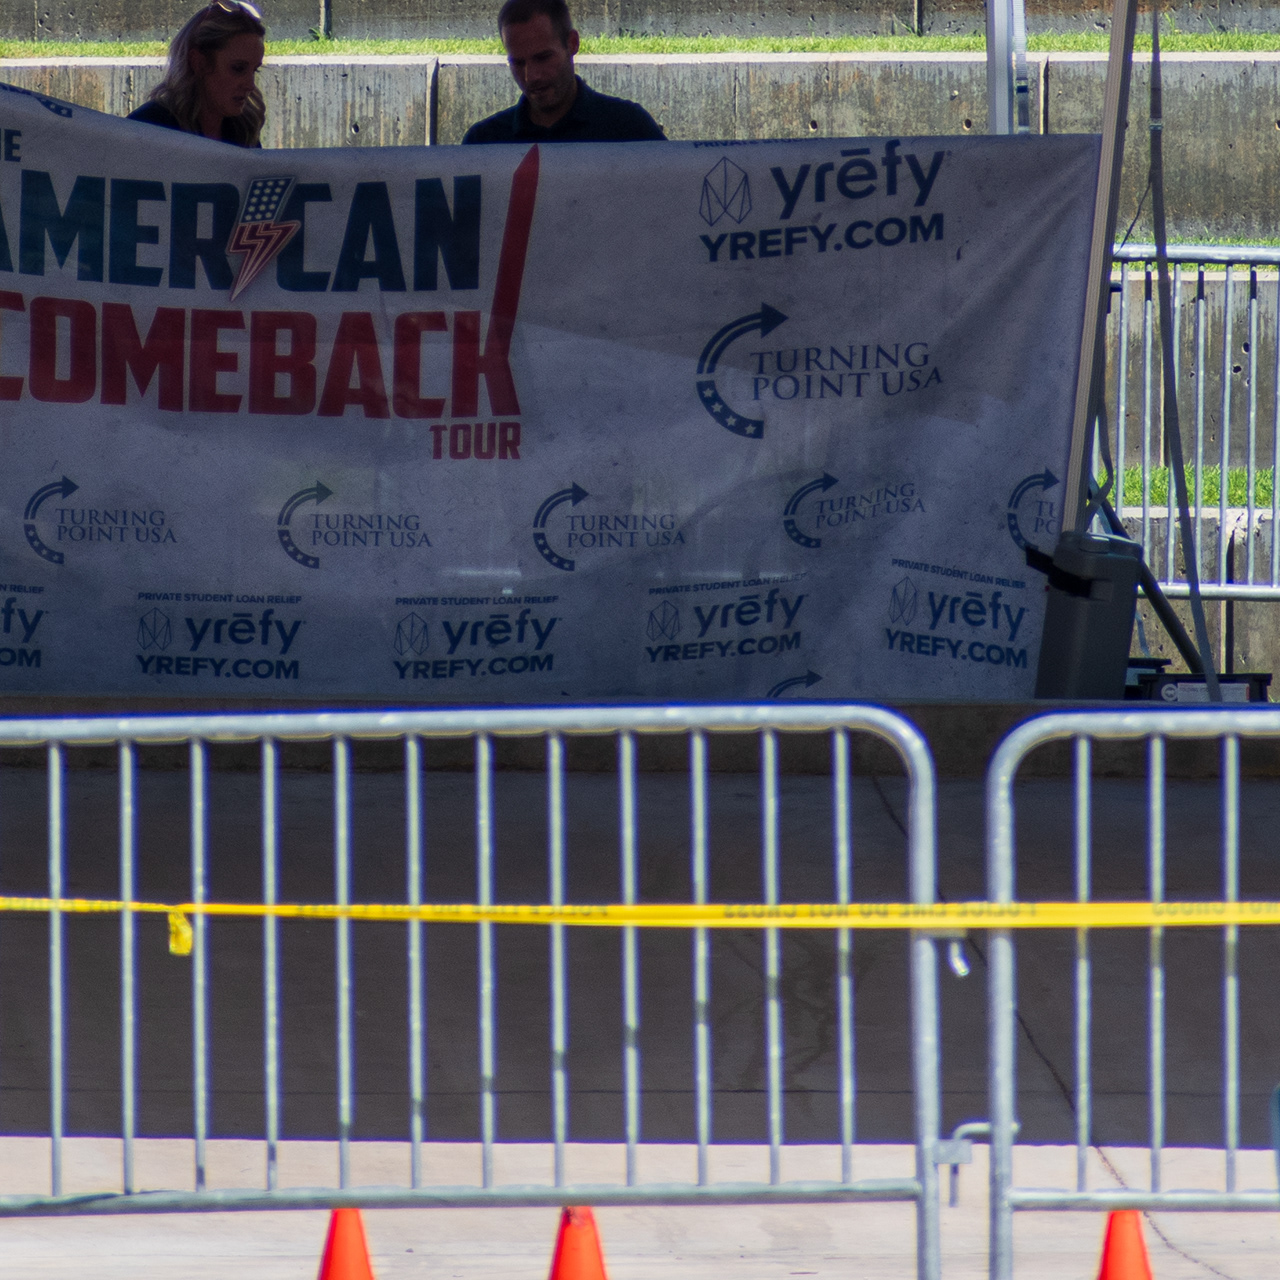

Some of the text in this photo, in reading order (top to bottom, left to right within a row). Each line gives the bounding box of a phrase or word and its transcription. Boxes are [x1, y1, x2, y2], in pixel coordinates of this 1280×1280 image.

[699, 213, 945, 262] YREFY.COM
[750, 342, 930, 375] TURNING
[752, 366, 943, 401] POINT USA
[428, 421, 520, 460] TOUR
[816, 483, 915, 515] TURNING
[55, 508, 166, 526] TURNING
[310, 513, 421, 532] TURNING
[565, 514, 676, 532] TURNING
[816, 495, 927, 529] POINT USA
[57, 524, 178, 543] POINT USA
[312, 529, 433, 548] POINT USA
[567, 530, 686, 548] POINT USA
[648, 585, 691, 596] PRIVATE
[693, 580, 741, 592] STUDENT
[742, 577, 770, 587] LOAN
[892, 559, 930, 573] PRIVATE
[970, 573, 994, 585] LOAN
[995, 577, 1026, 589] RELIEF
[9, 584, 45, 594] RELIEF
[138, 592, 302, 604] PRIVATE STUDENT LOAN RELIEF
[395, 595, 559, 606] PRIVATE STUDENT LOAN RELIEF
[645, 631, 802, 663] YREFY.COM
[885, 628, 1028, 669] YREFY.COM
[136, 655, 299, 680] YREFY.COM
[393, 654, 554, 679] YREFY.COM
